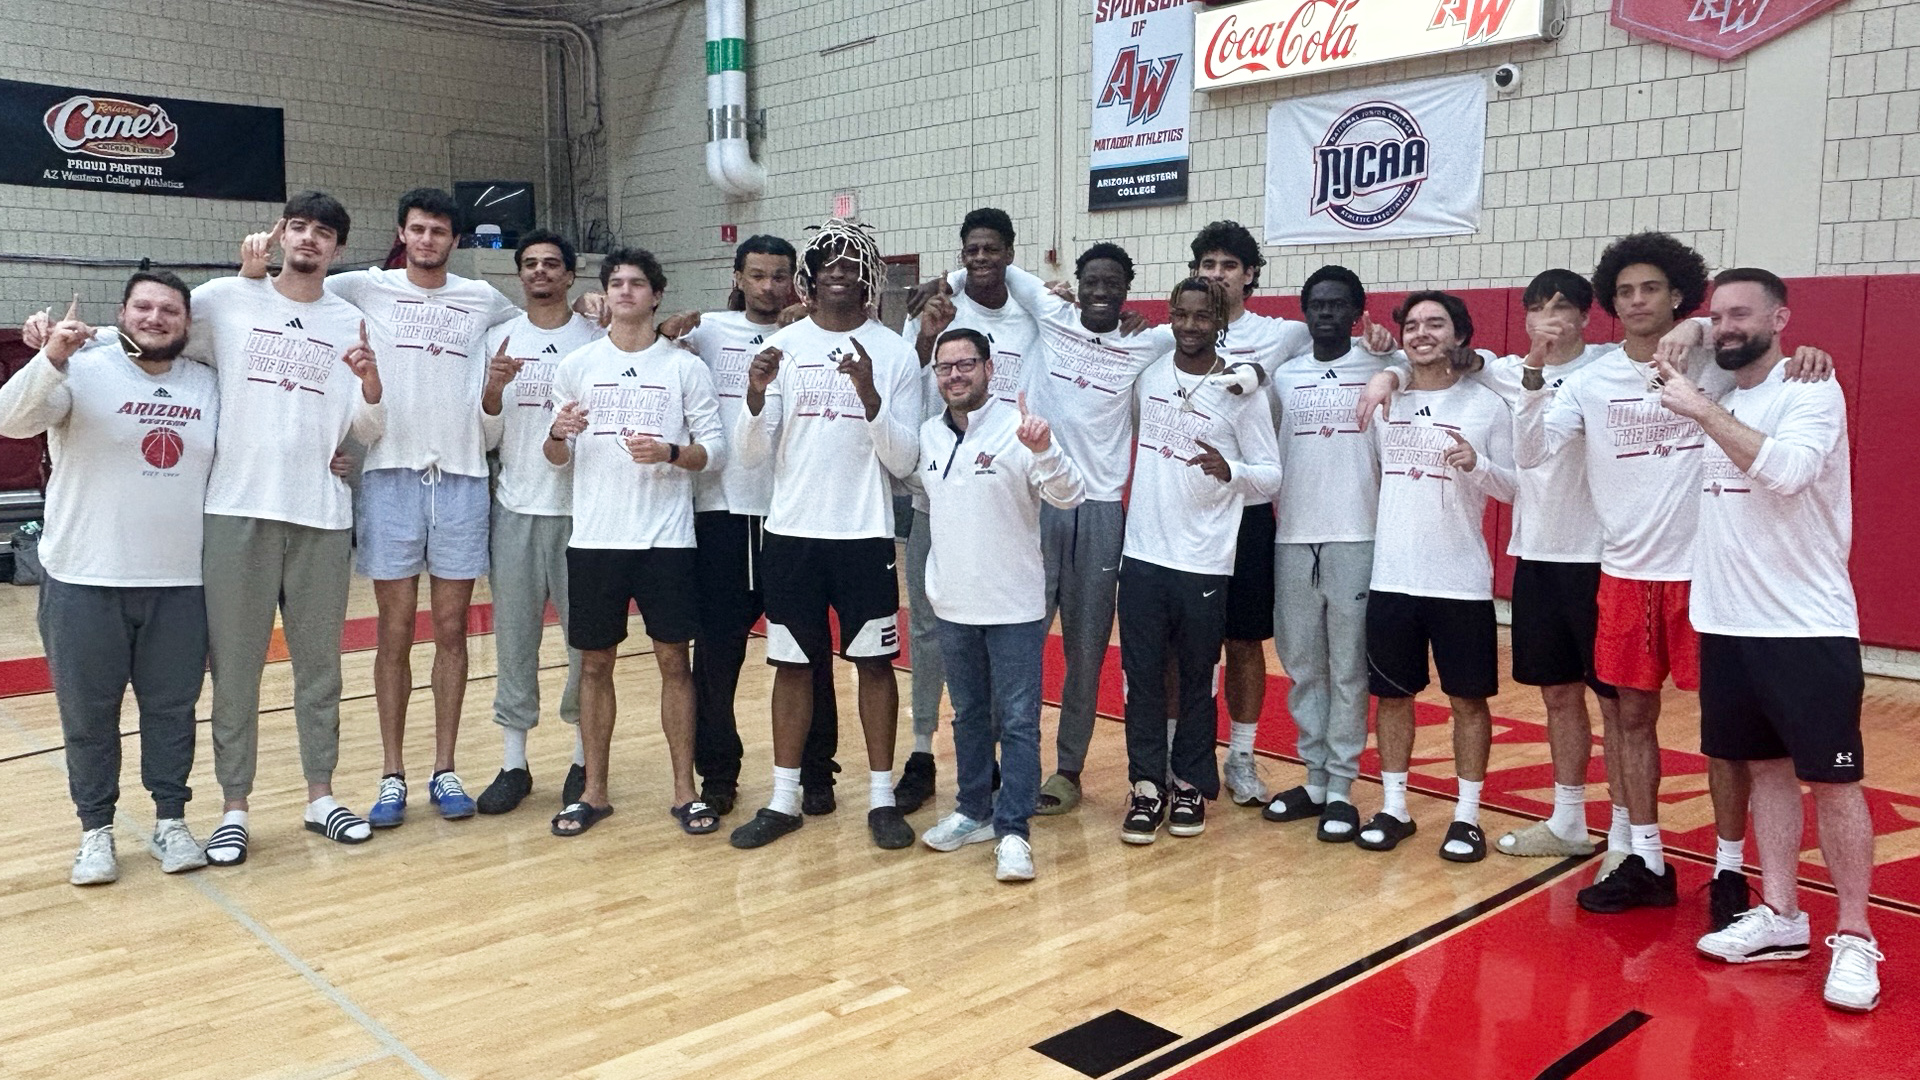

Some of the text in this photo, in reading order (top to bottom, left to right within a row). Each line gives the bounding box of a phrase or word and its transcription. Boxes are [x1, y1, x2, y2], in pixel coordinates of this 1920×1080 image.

[1131, 20, 1147, 37] OF
[1204, 0, 1359, 80] Coca-Cola
[1096, 44, 1184, 127] AW
[54, 96, 174, 148] Cane's
[1094, 128, 1184, 153] MATADOR ATHLETICS
[67, 159, 163, 176] PROUD PARTNER
[1315, 138, 1426, 207] NJCAA
[43, 169, 58, 180] AZ
[61, 171, 103, 183] Western
[106, 174, 141, 188] College
[1097, 171, 1178, 188] ARIZONA WESTERN
[1118, 185, 1156, 197] COLLEGE
[389, 303, 477, 334] DOMINATE
[395, 324, 421, 338] THE
[245, 332, 338, 369] DOMINATE
[248, 354, 276, 373] THE
[116, 401, 201, 420] ARIZONA
[139, 418, 187, 427] WESTERN
